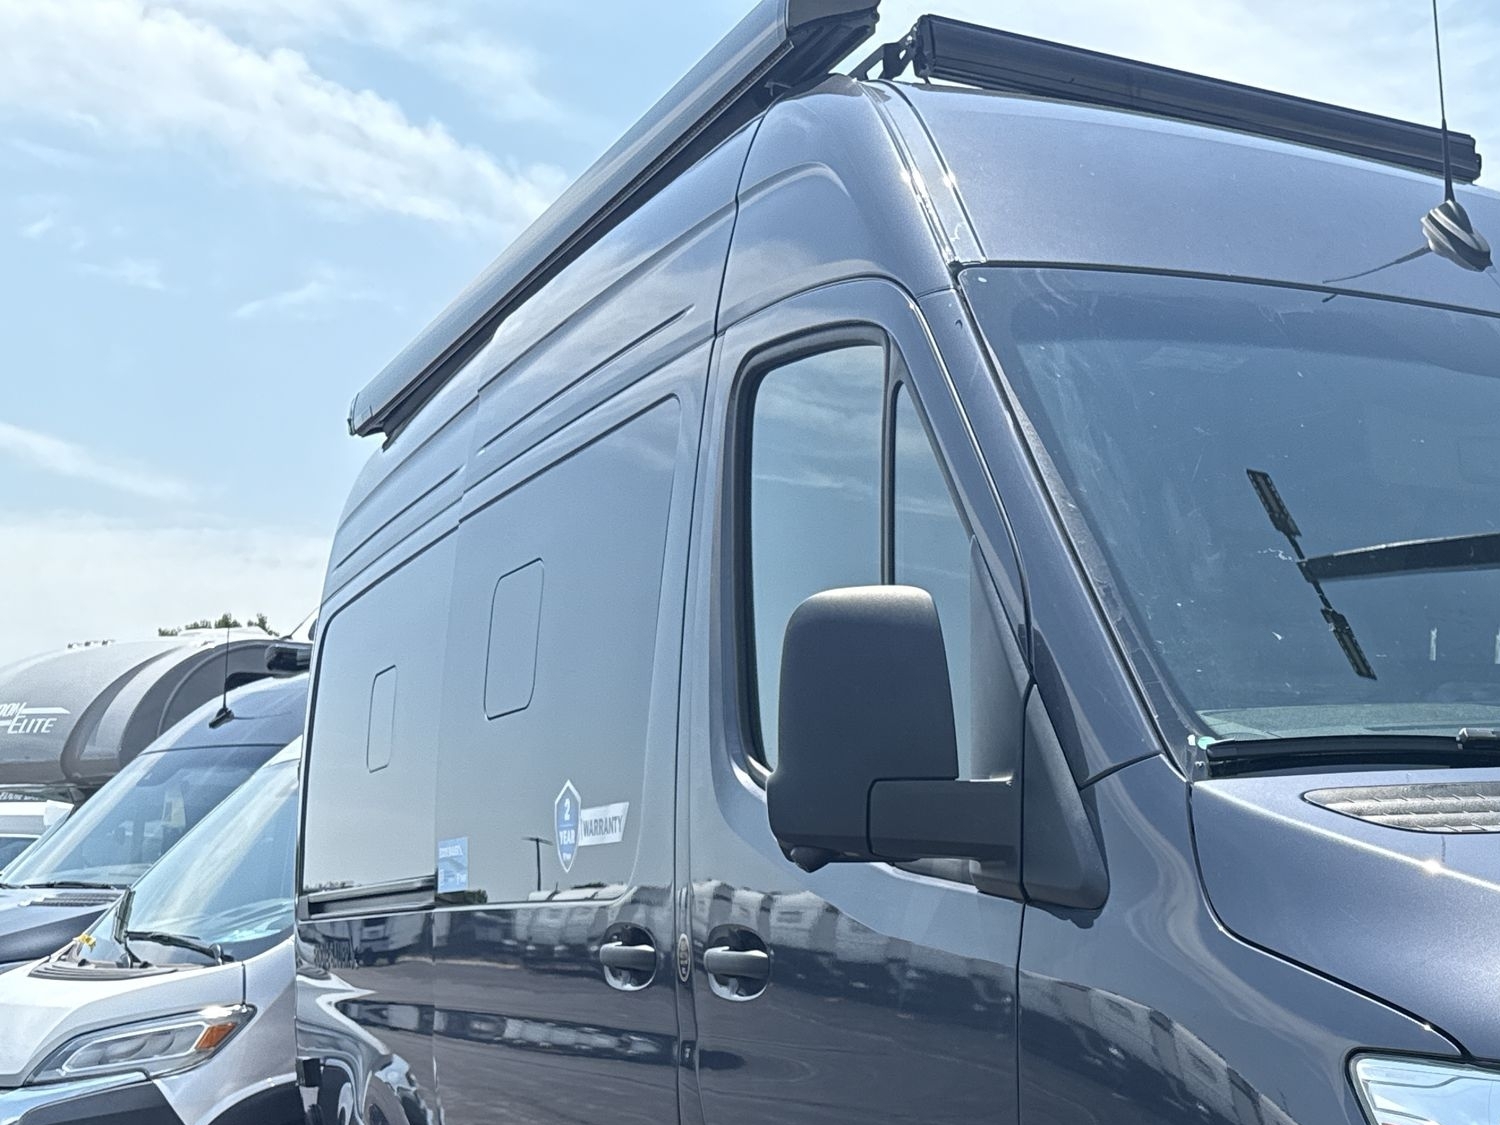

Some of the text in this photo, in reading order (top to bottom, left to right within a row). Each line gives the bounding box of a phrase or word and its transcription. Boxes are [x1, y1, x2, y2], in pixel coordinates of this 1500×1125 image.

[7, 715, 57, 734] ELITE
[564, 798, 571, 821] 2
[559, 829, 576, 845] YEAR
[583, 815, 623, 838] WARRANTY
